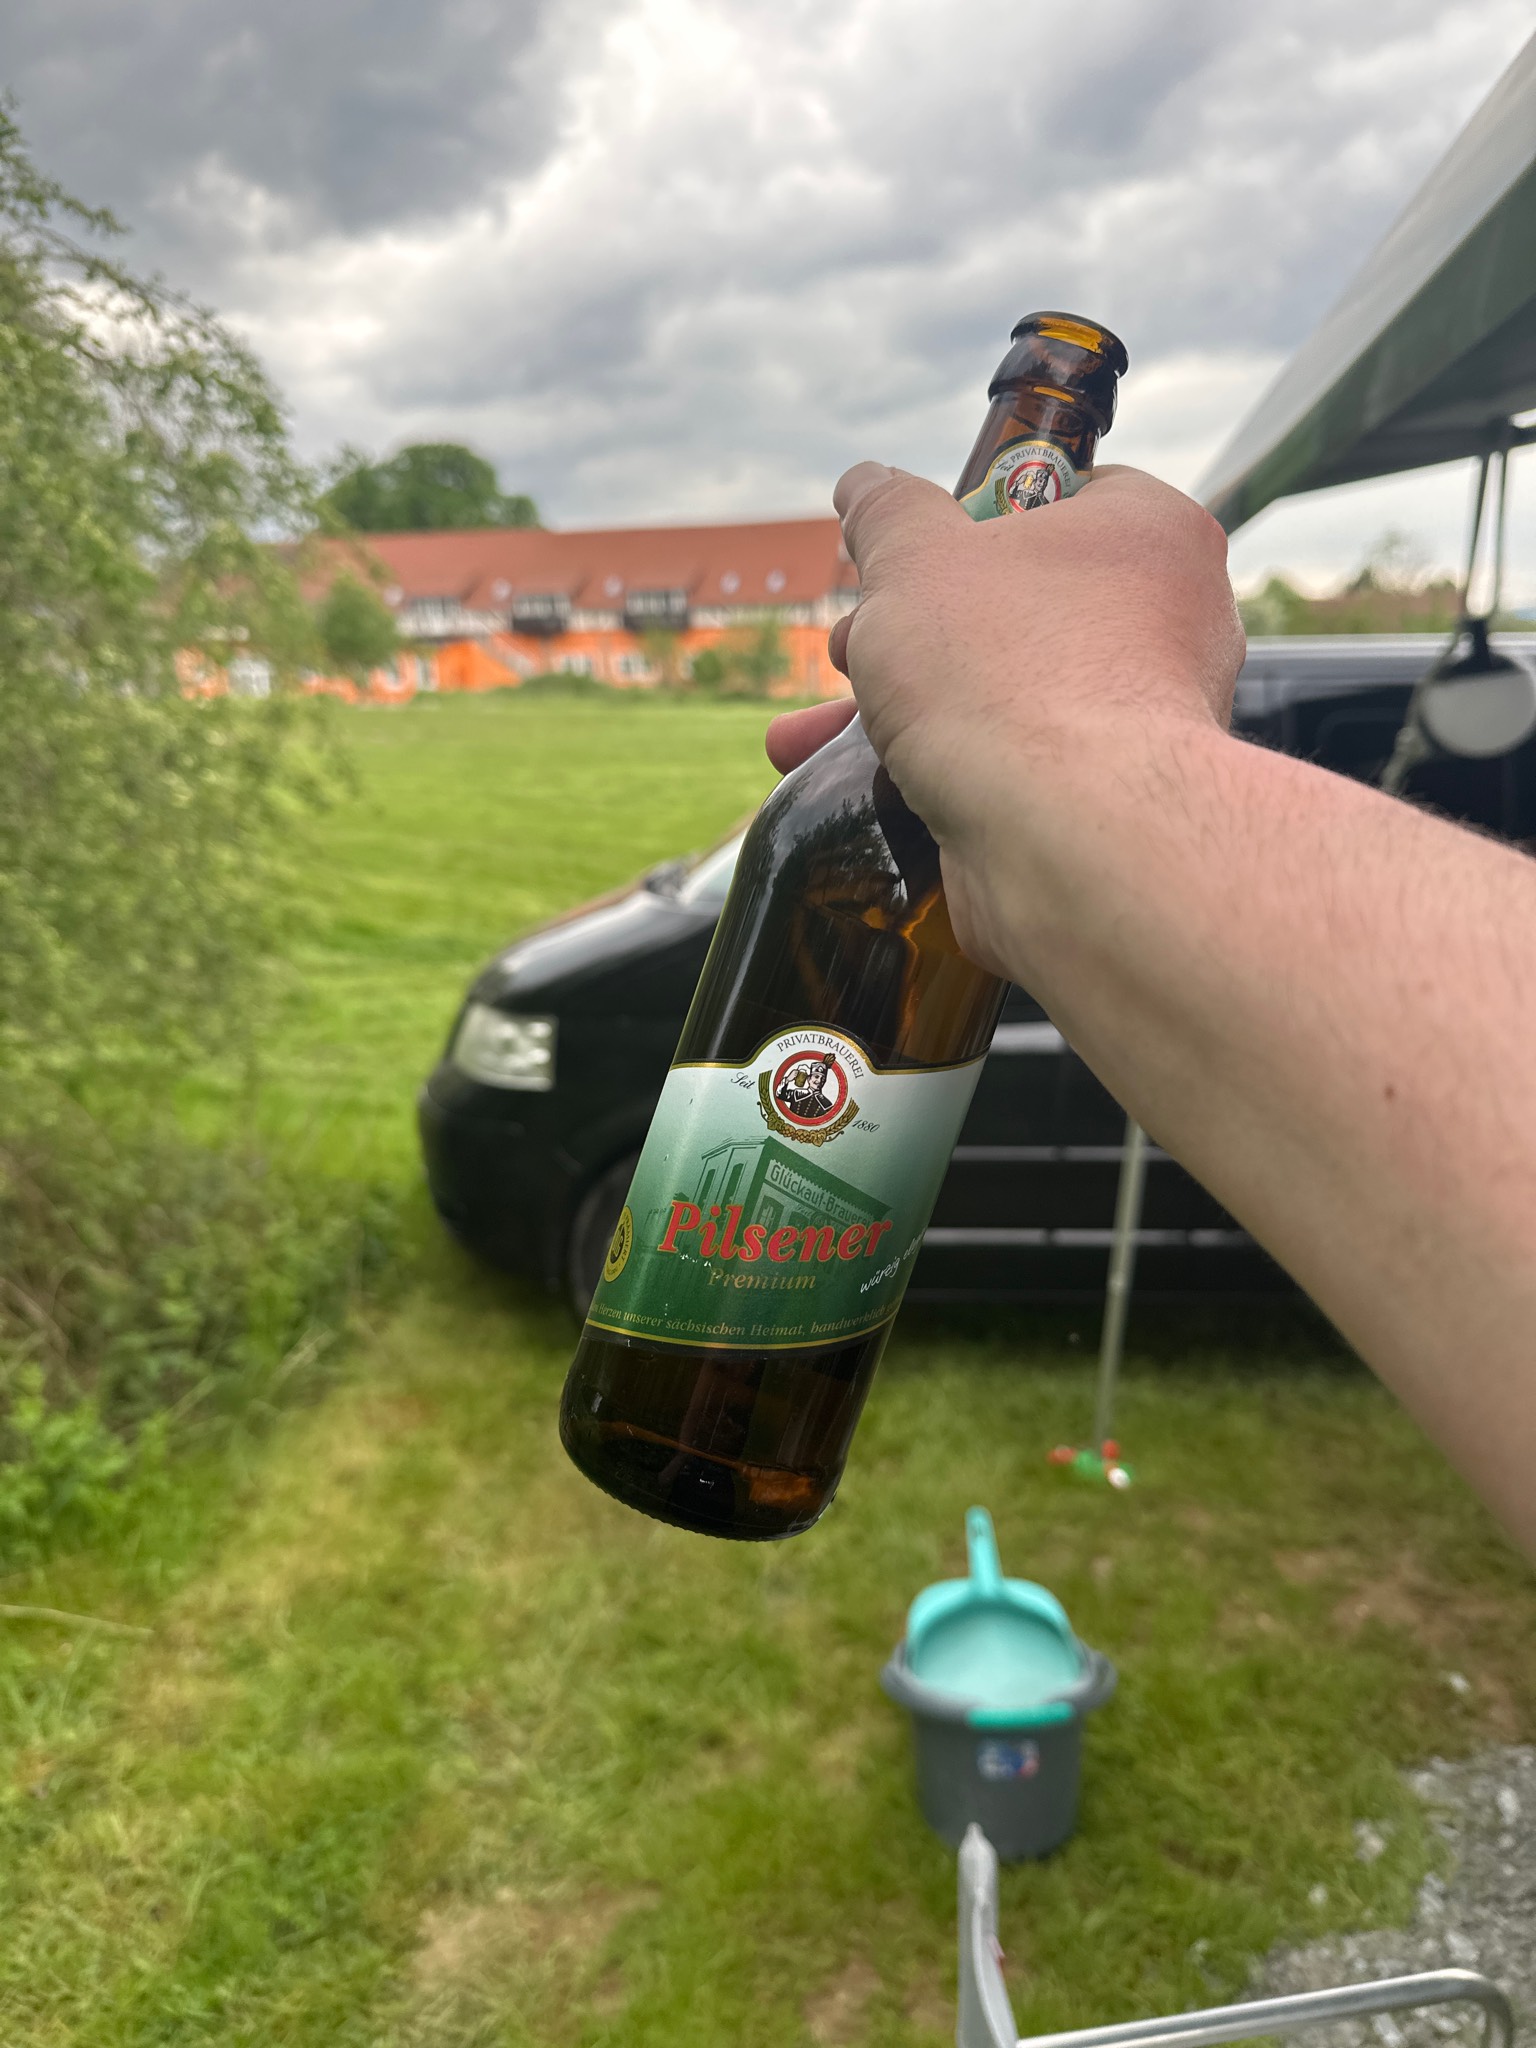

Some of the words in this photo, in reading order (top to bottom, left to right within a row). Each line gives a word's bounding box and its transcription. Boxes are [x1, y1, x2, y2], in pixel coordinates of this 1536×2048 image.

[1010, 447, 1072, 488] PRIVATBRAUEREI
[776, 1033, 865, 1080] PRIVATBRAUEREI
[730, 1071, 756, 1090] Seit
[852, 1118, 881, 1134] 1880
[769, 1163, 872, 1228] Glückauf-Brauere
[657, 1199, 894, 1263] Pilsener
[706, 1266, 817, 1290] Premium
[859, 1255, 901, 1294] würzig
[622, 1311, 664, 1328] unserer
[665, 1317, 746, 1336] sächsischen
[749, 1323, 806, 1337] Heimat,
